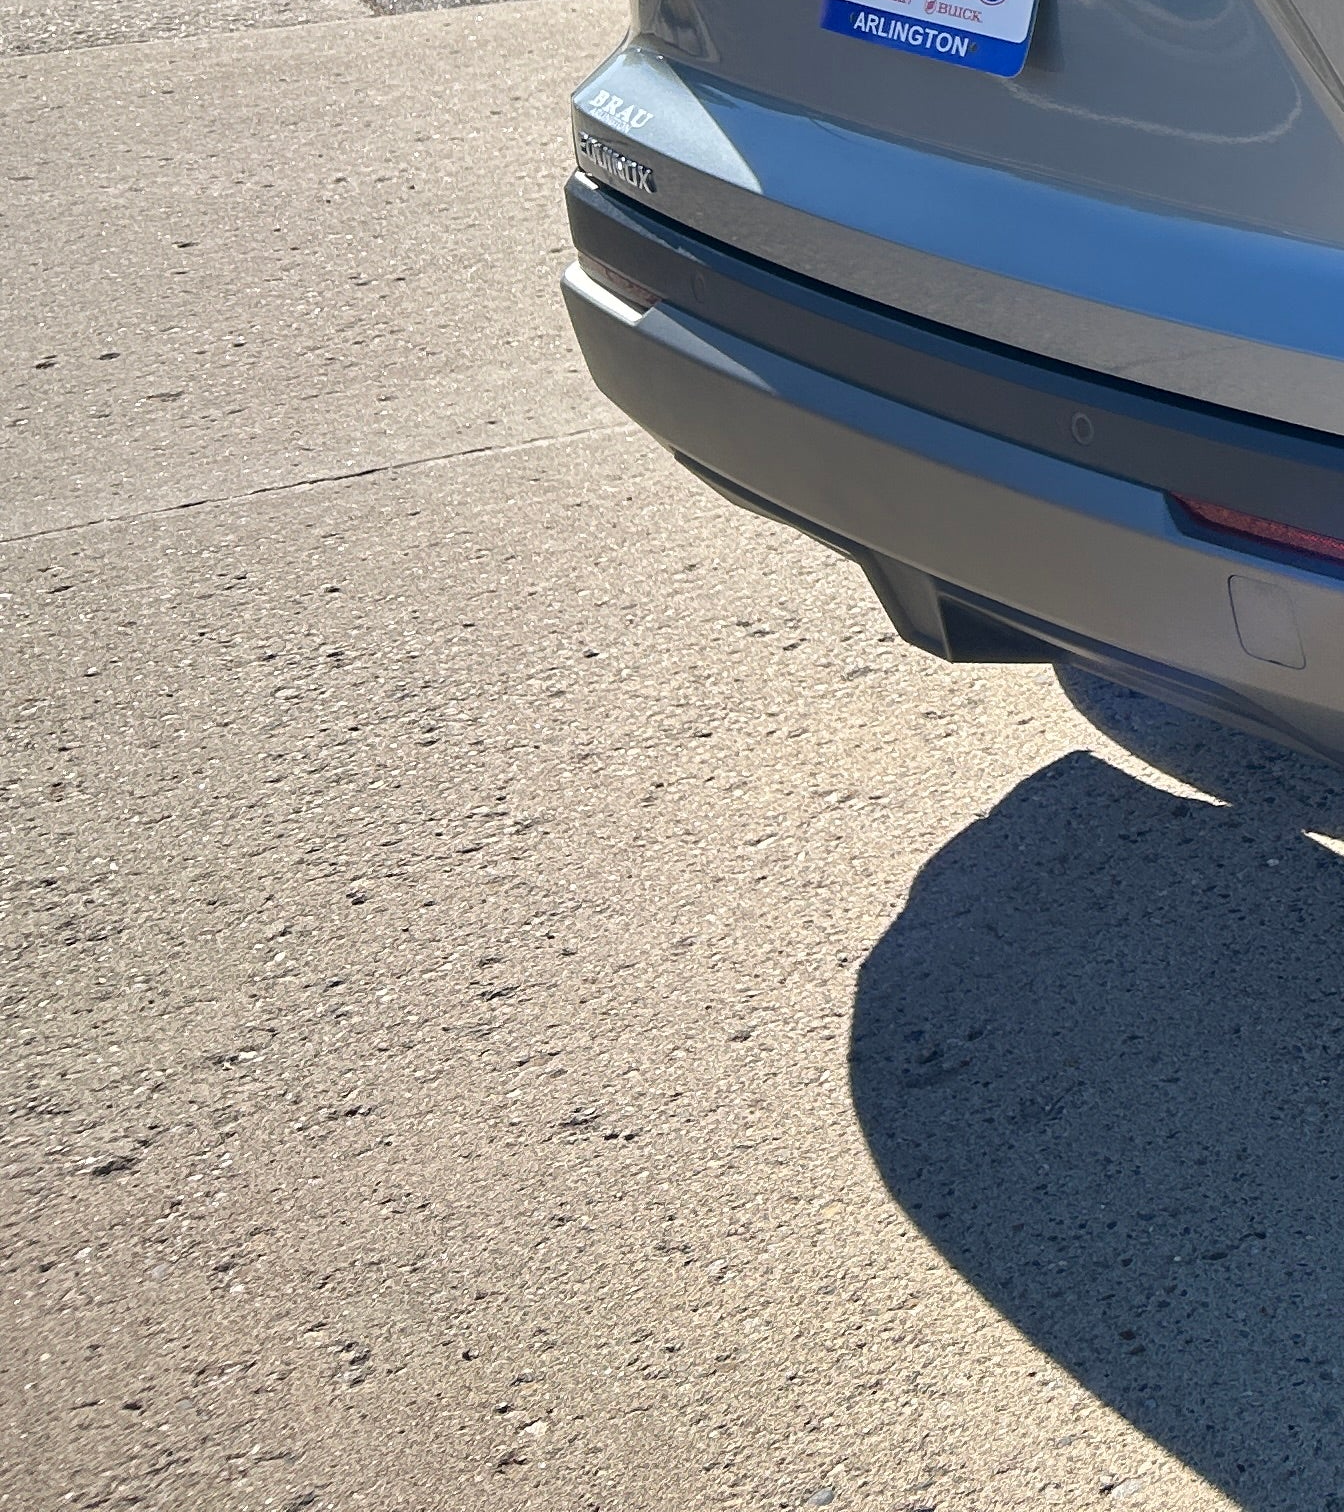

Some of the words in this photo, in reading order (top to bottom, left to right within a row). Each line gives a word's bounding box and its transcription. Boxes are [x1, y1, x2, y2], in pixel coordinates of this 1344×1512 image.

[937, 1, 983, 24] BUICK
[853, 11, 969, 57] ARLINGTON
[589, 90, 654, 128] BRAU
